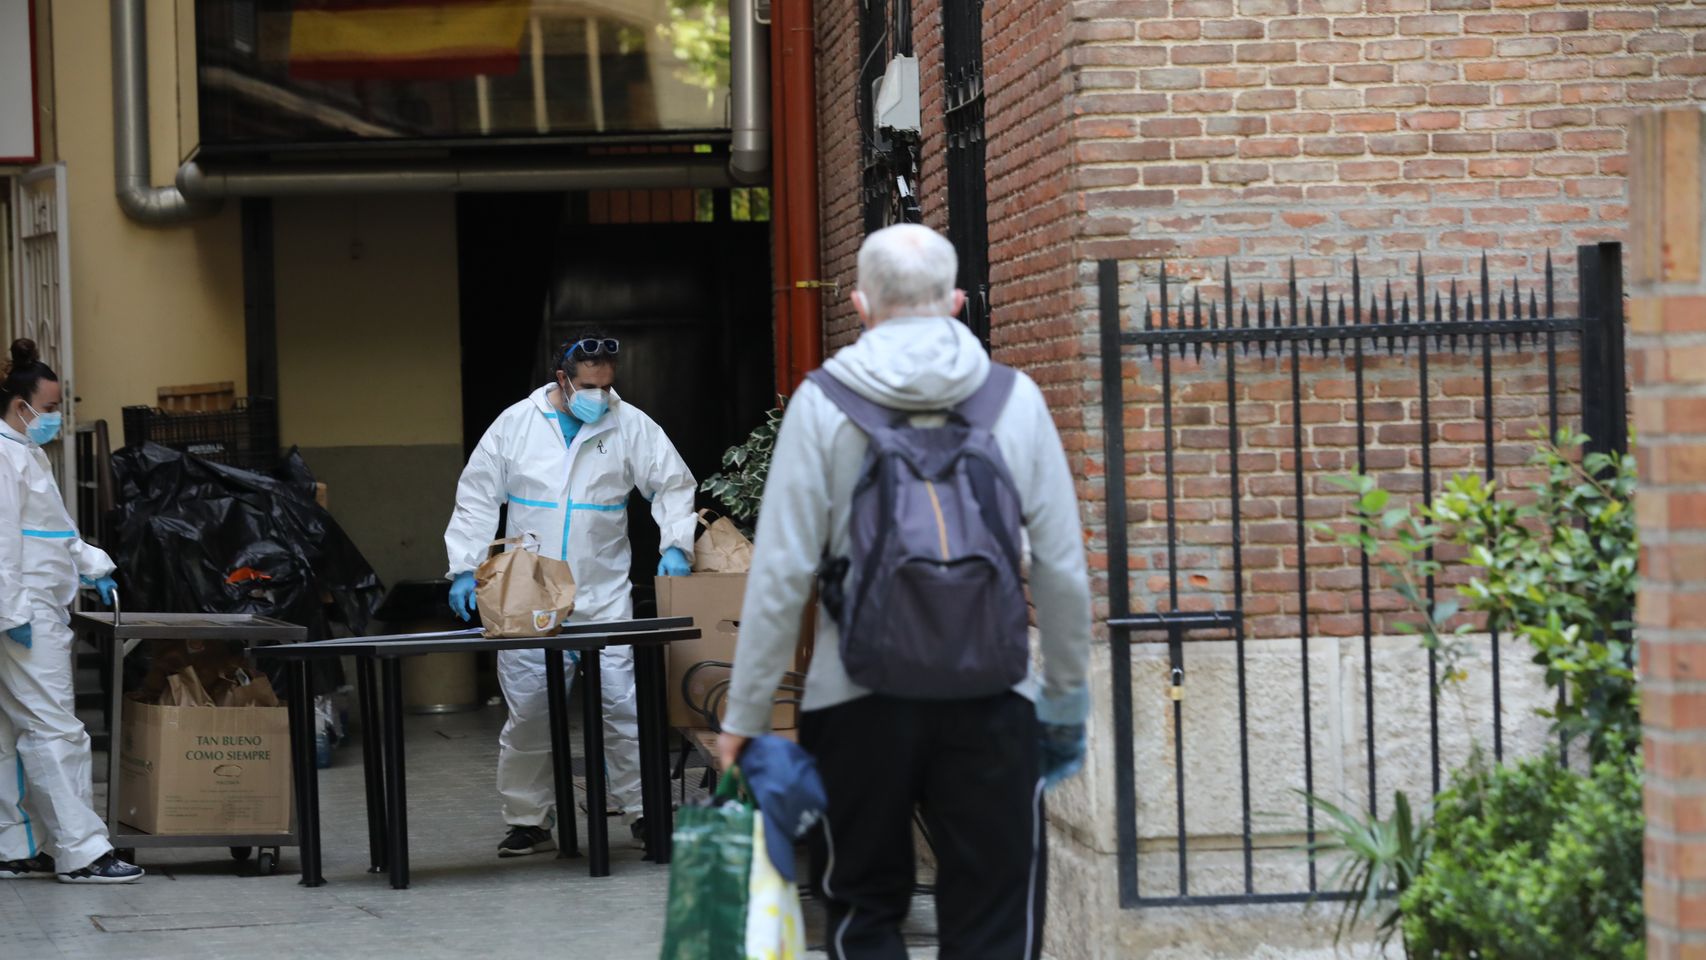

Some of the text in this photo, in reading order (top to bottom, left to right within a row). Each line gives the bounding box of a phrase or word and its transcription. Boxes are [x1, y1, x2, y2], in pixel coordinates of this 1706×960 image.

[196, 736, 262, 746] TAN BUENO
[185, 750, 271, 761] COMO SIEMPRE
